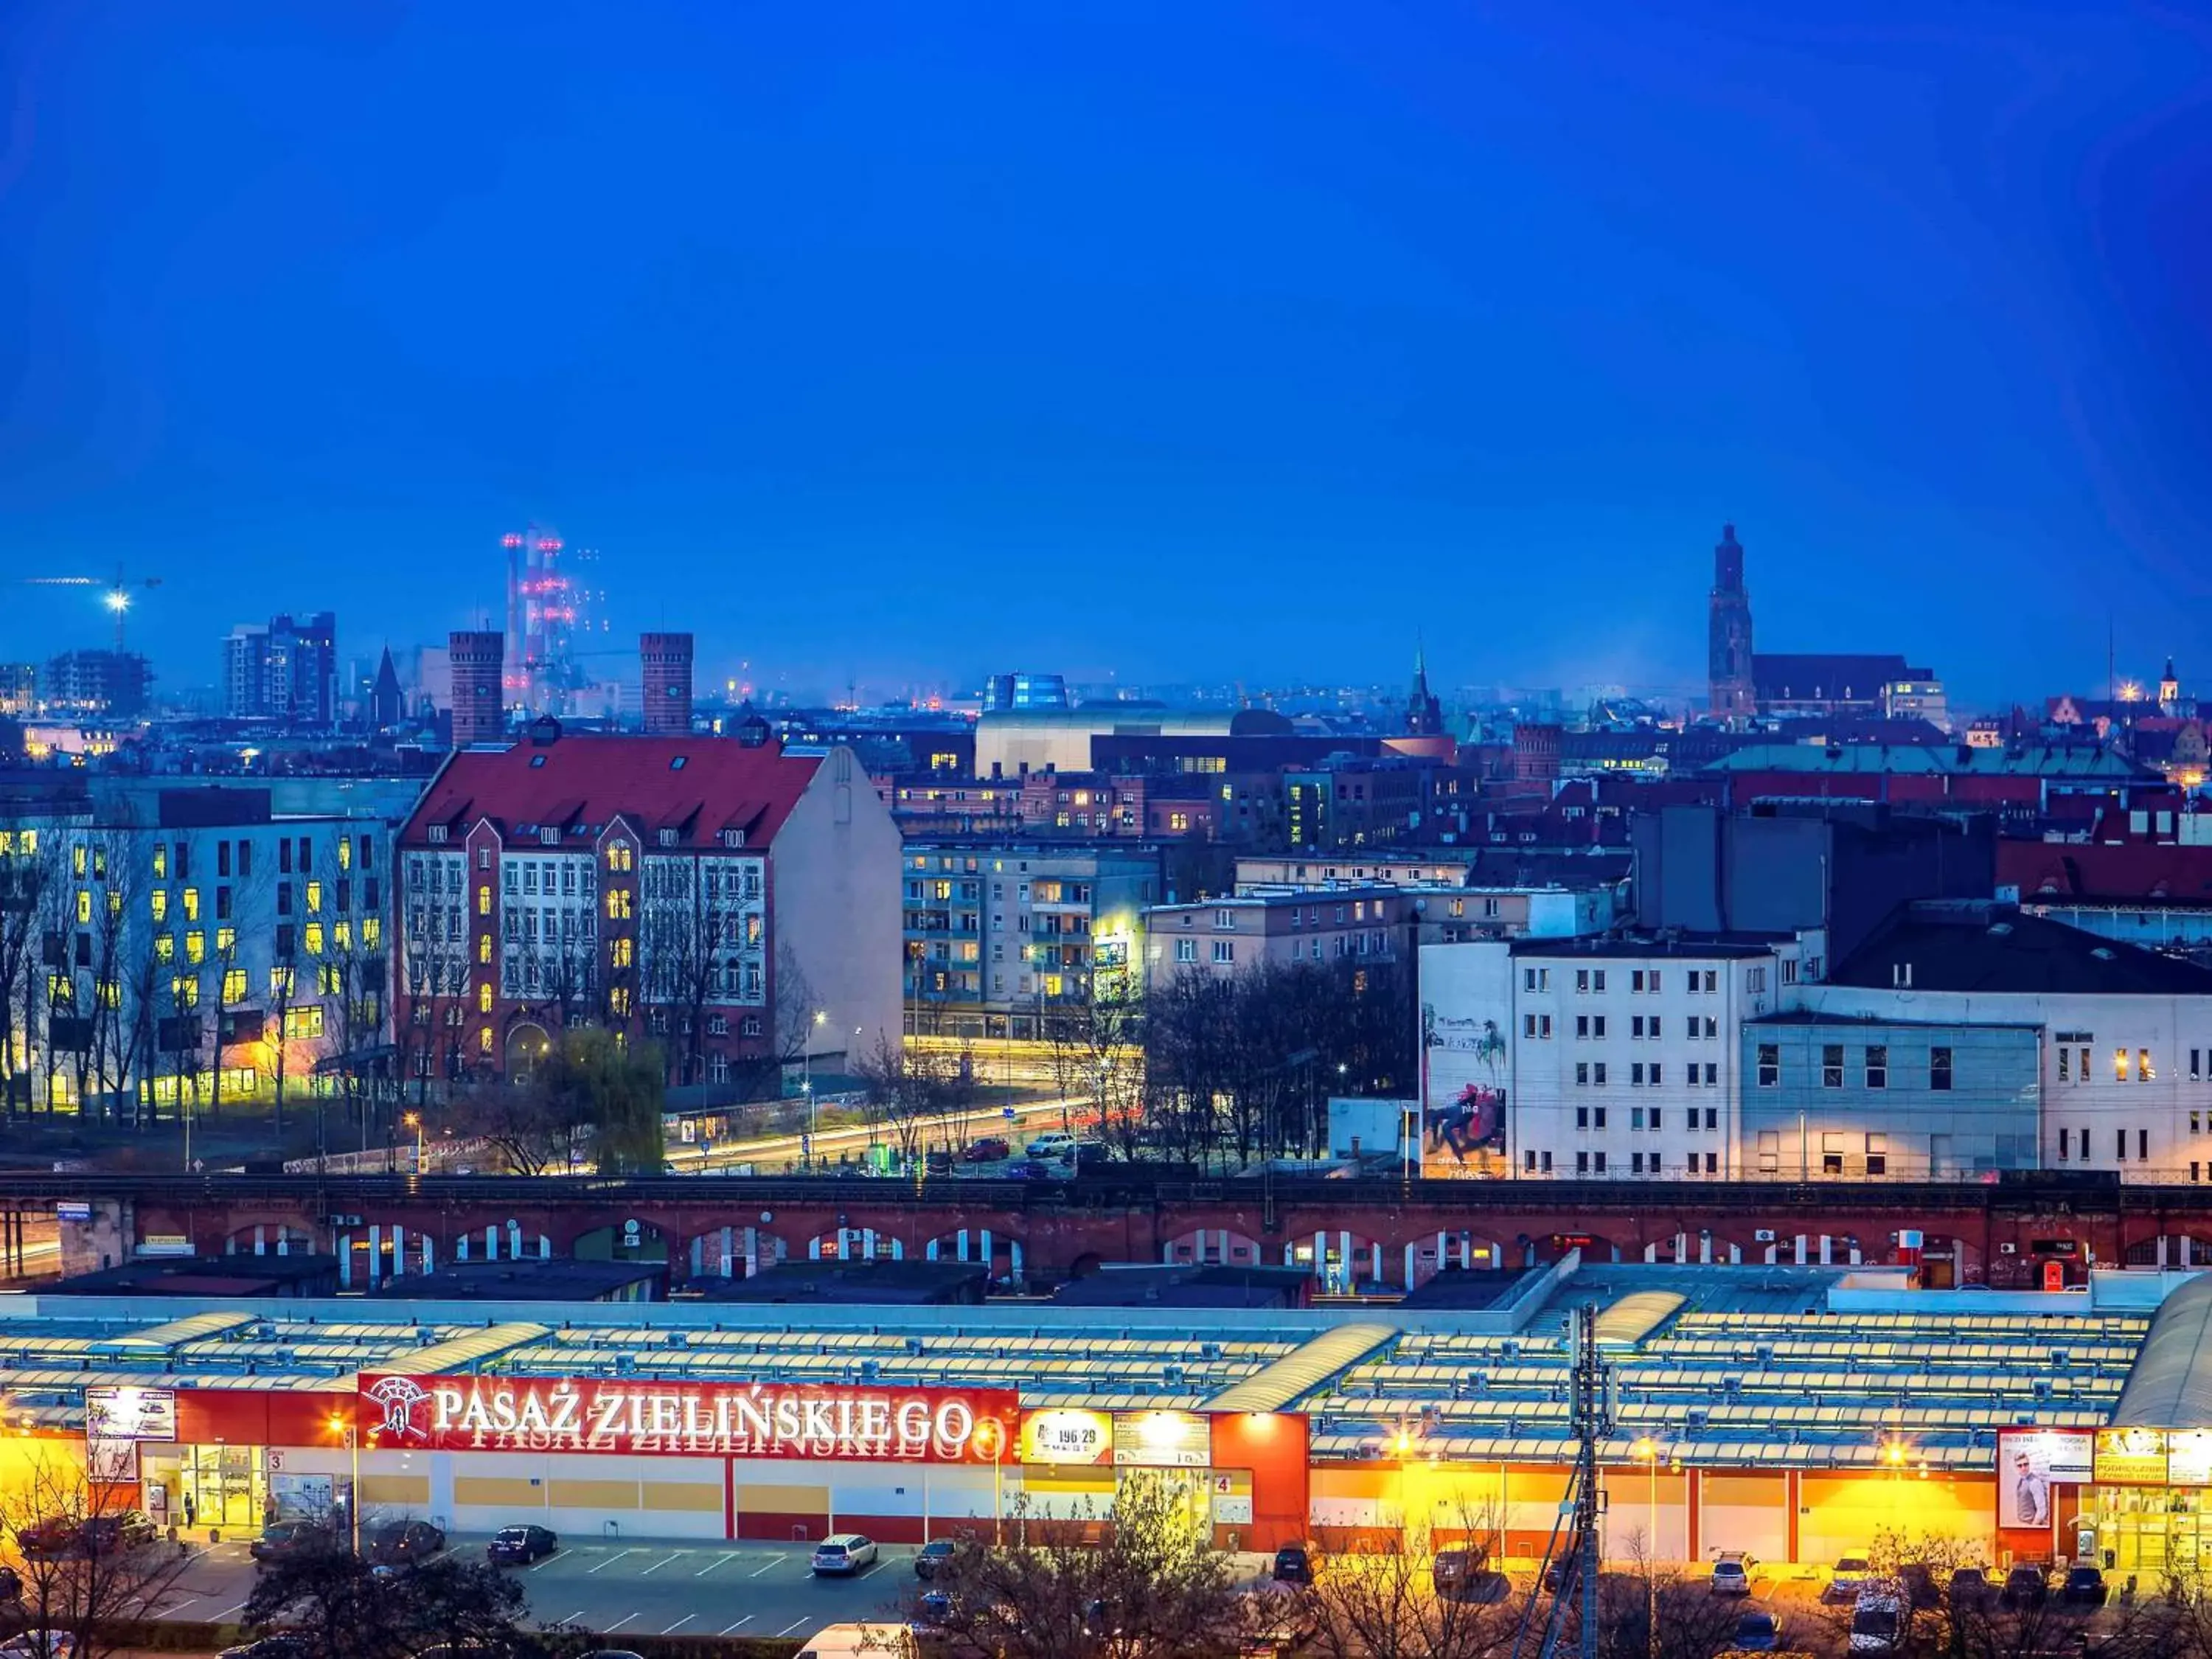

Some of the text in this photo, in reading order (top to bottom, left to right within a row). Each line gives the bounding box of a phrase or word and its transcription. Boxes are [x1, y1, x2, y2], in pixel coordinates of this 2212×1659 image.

[432, 1382, 974, 1443] PASAŻ ZIELIŃSKIEGO
[272, 1455, 280, 1468] 3
[1218, 1478, 1228, 1491] 4
